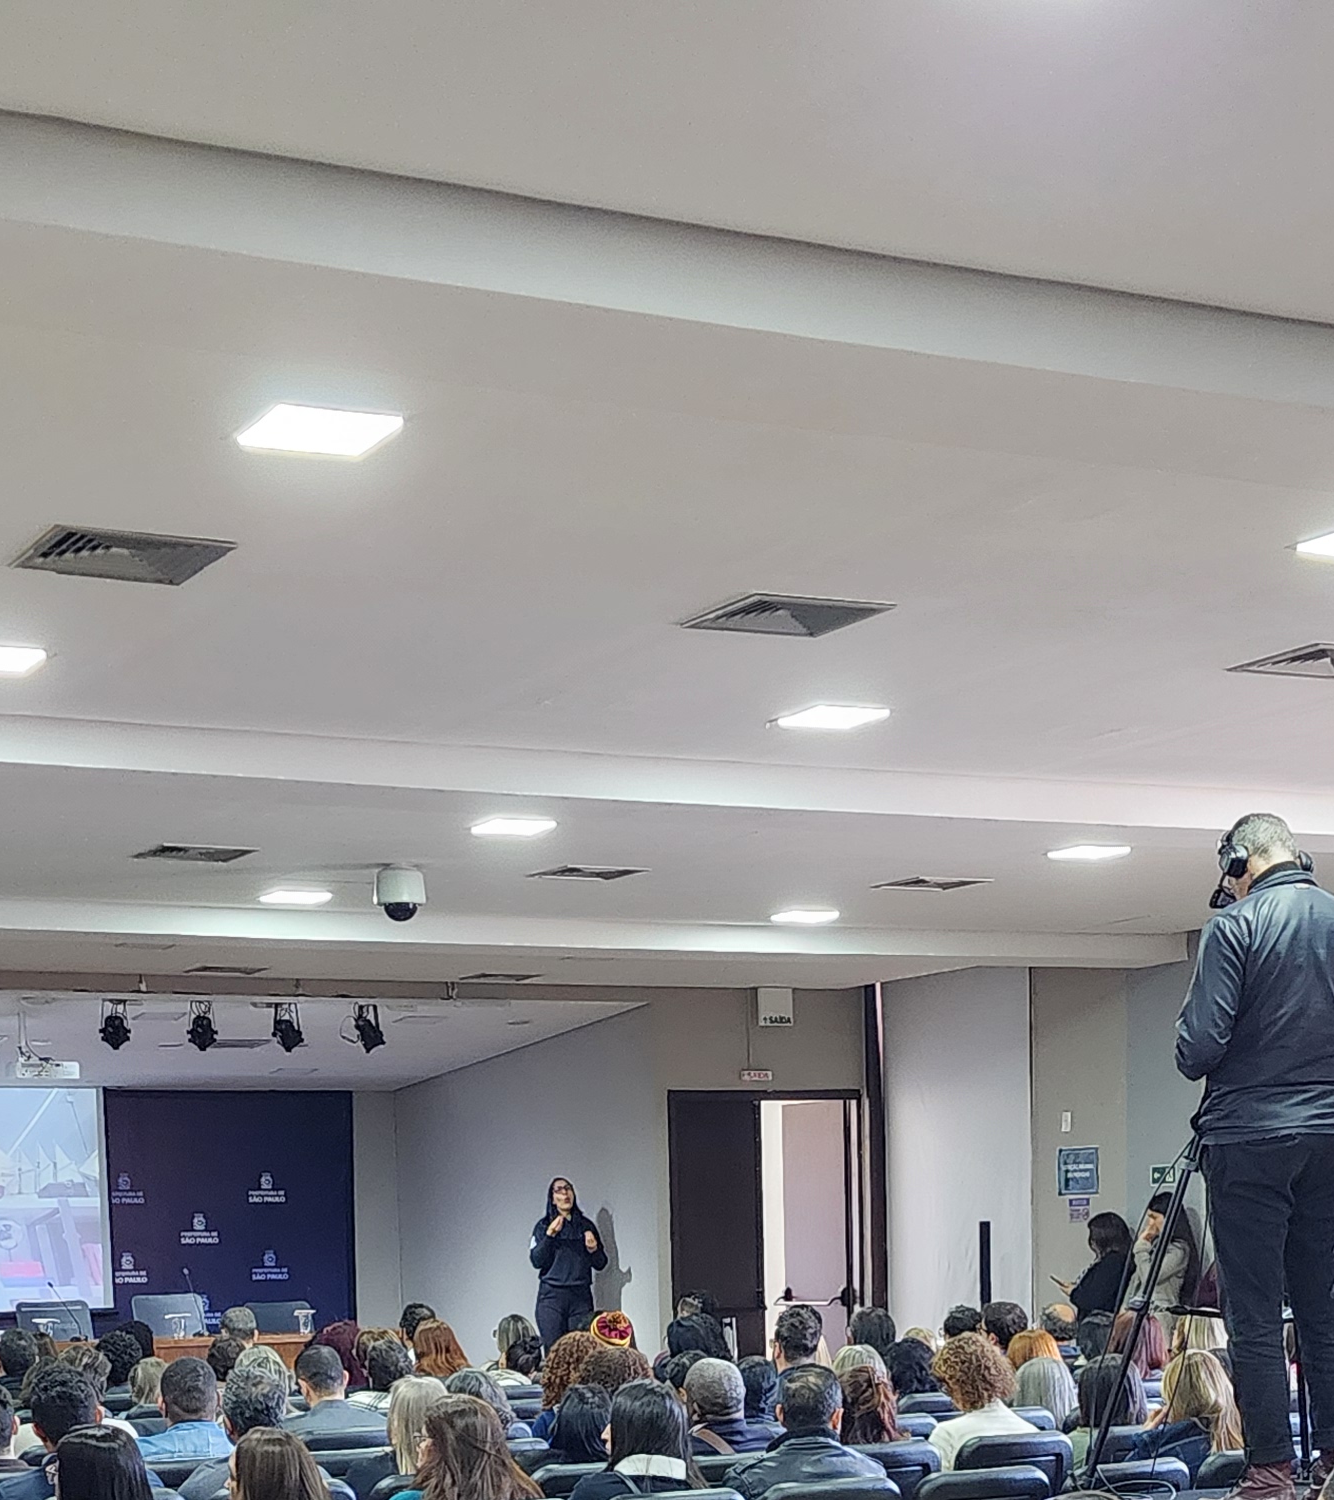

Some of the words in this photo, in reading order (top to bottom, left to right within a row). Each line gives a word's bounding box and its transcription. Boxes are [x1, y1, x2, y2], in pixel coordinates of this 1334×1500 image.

[769, 1015, 792, 1024] SAÍDA
[248, 1195, 263, 1203] SÃO
[180, 1236, 195, 1244] SÃO
[252, 1272, 266, 1280] SÃO
